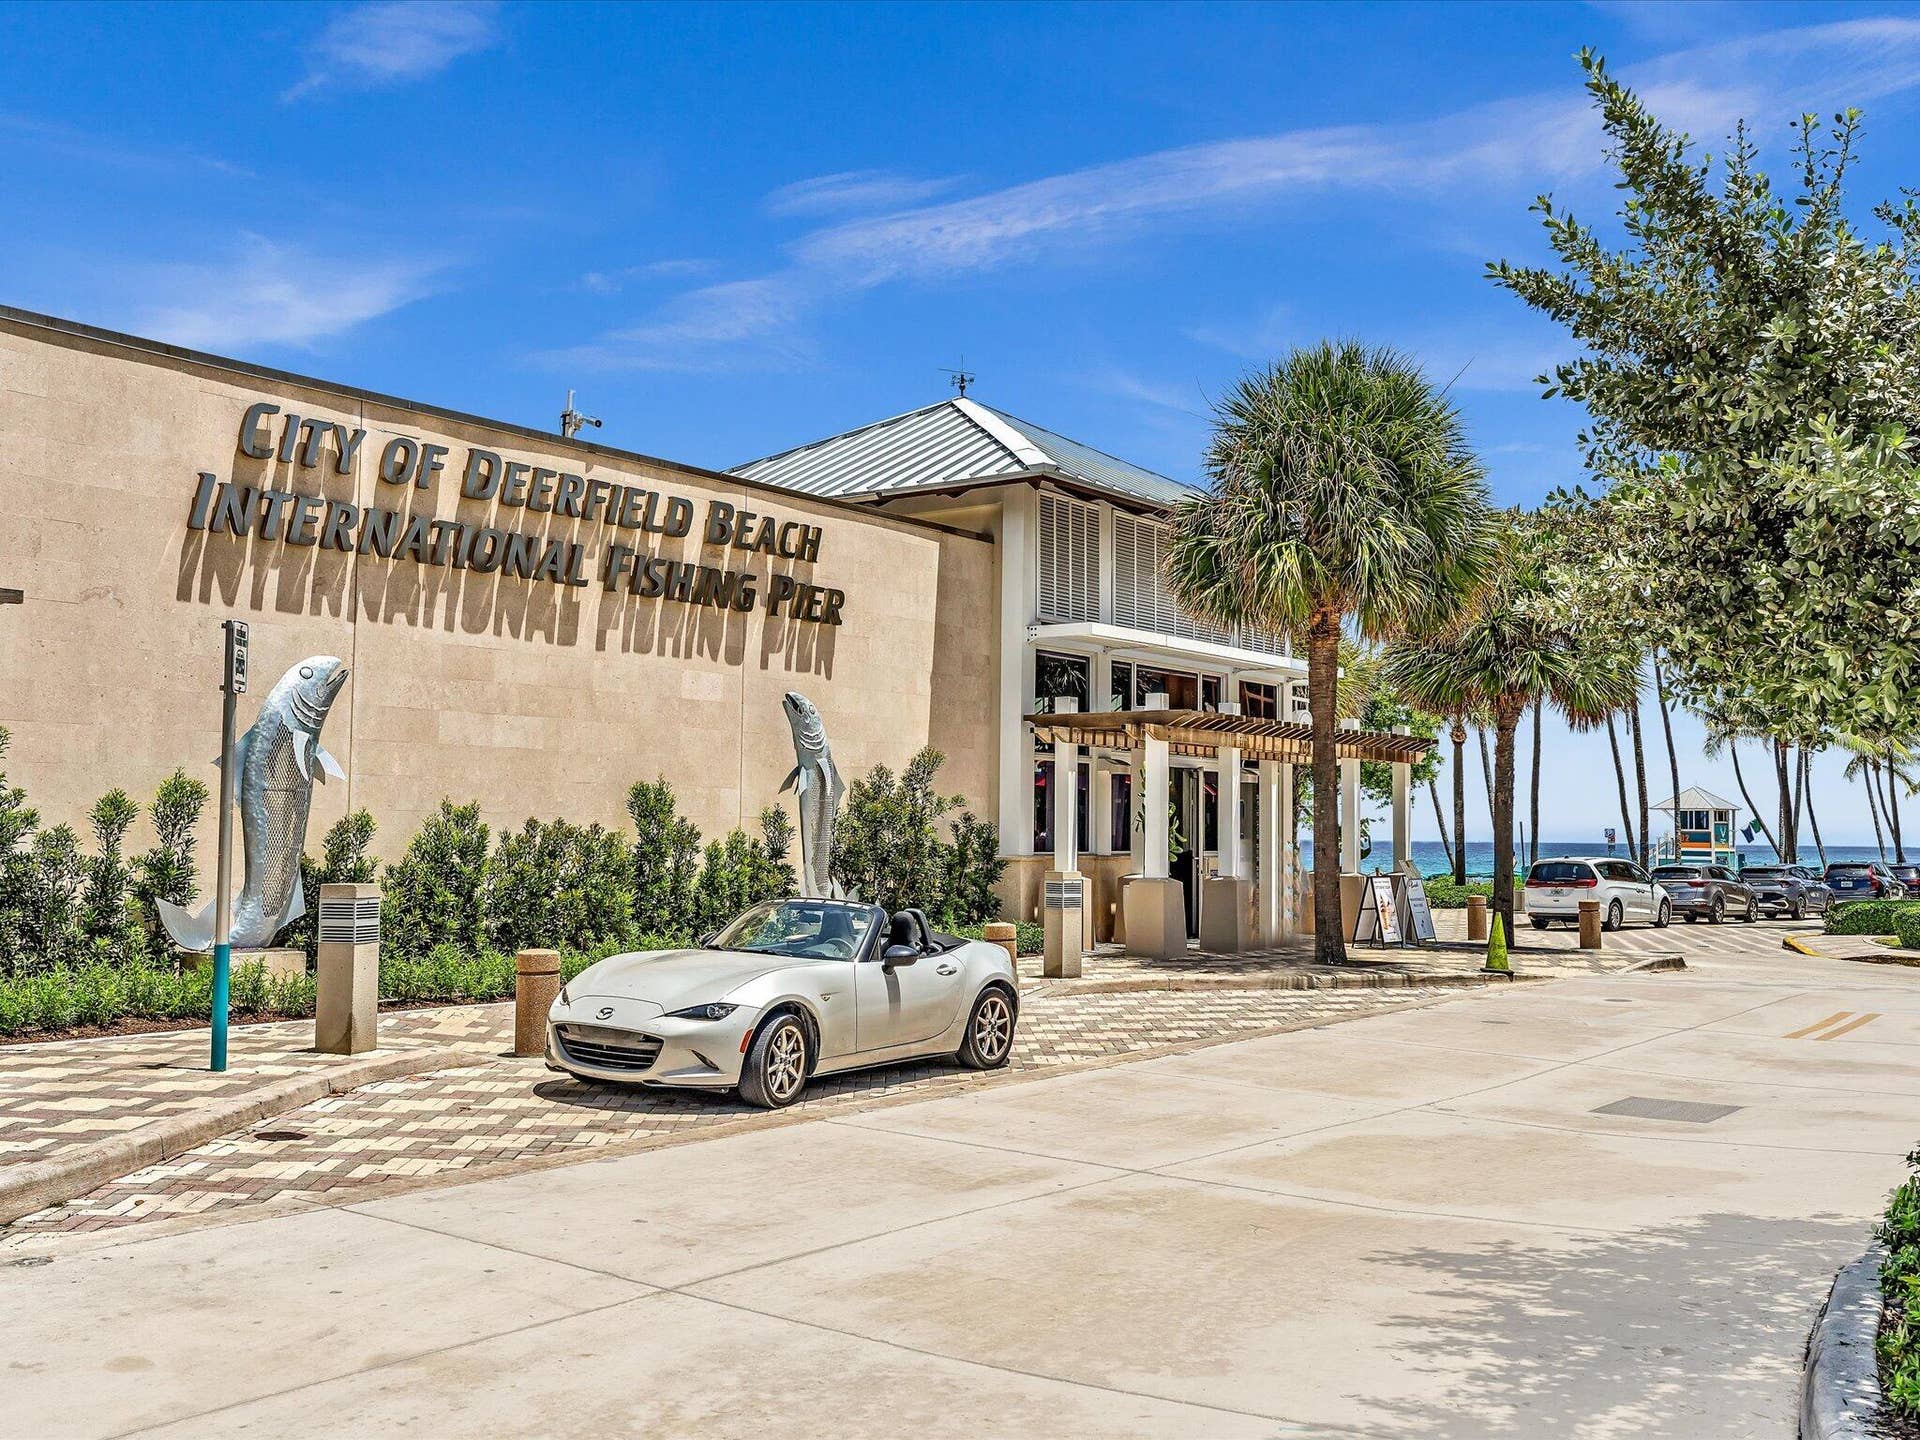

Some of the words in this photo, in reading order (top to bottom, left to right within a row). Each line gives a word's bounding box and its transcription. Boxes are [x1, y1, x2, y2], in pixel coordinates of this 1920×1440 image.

[187, 472, 589, 588] INTERNATIONAL
[602, 544, 757, 612] FISHING
[767, 574, 845, 626] PIER
[239, 402, 367, 475] CITY
[381, 437, 449, 489] OF
[460, 447, 694, 537] DEERFIELD
[705, 500, 823, 563] BEACH
